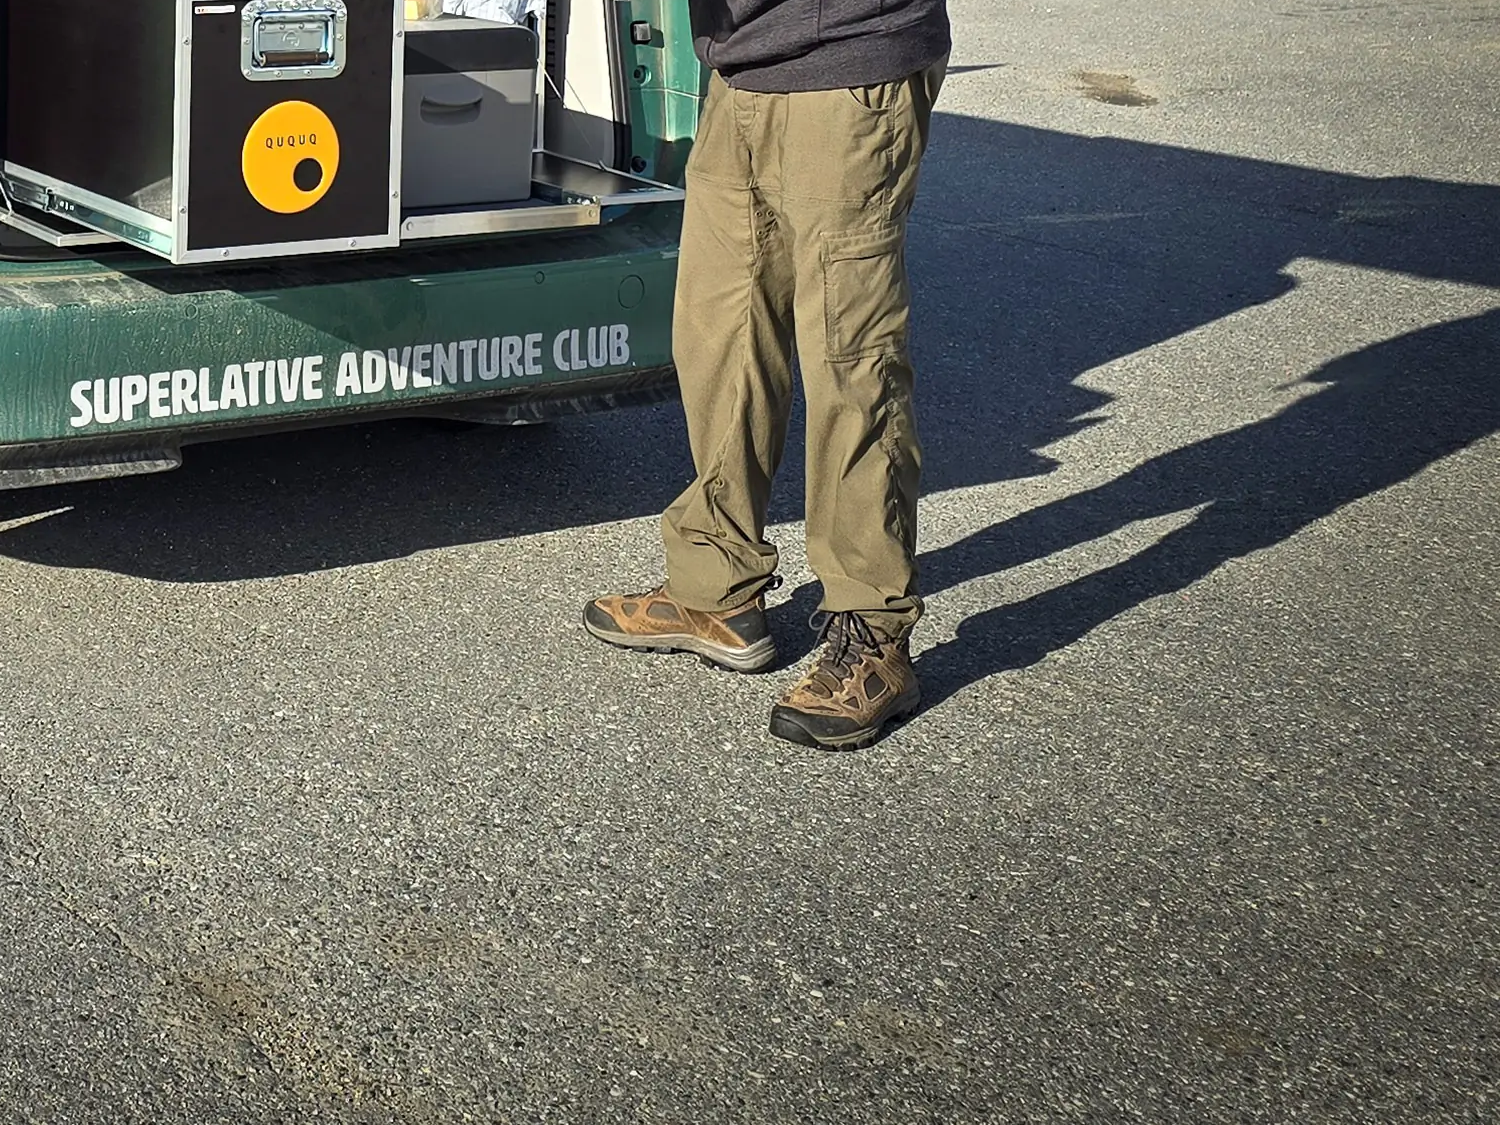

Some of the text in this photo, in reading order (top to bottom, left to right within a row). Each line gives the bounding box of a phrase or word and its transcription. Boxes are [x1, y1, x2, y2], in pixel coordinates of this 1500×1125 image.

[265, 133, 317, 149] QUQUQ
[69, 324, 630, 427] SUPERLATIVE ADVENTURE CLUB
